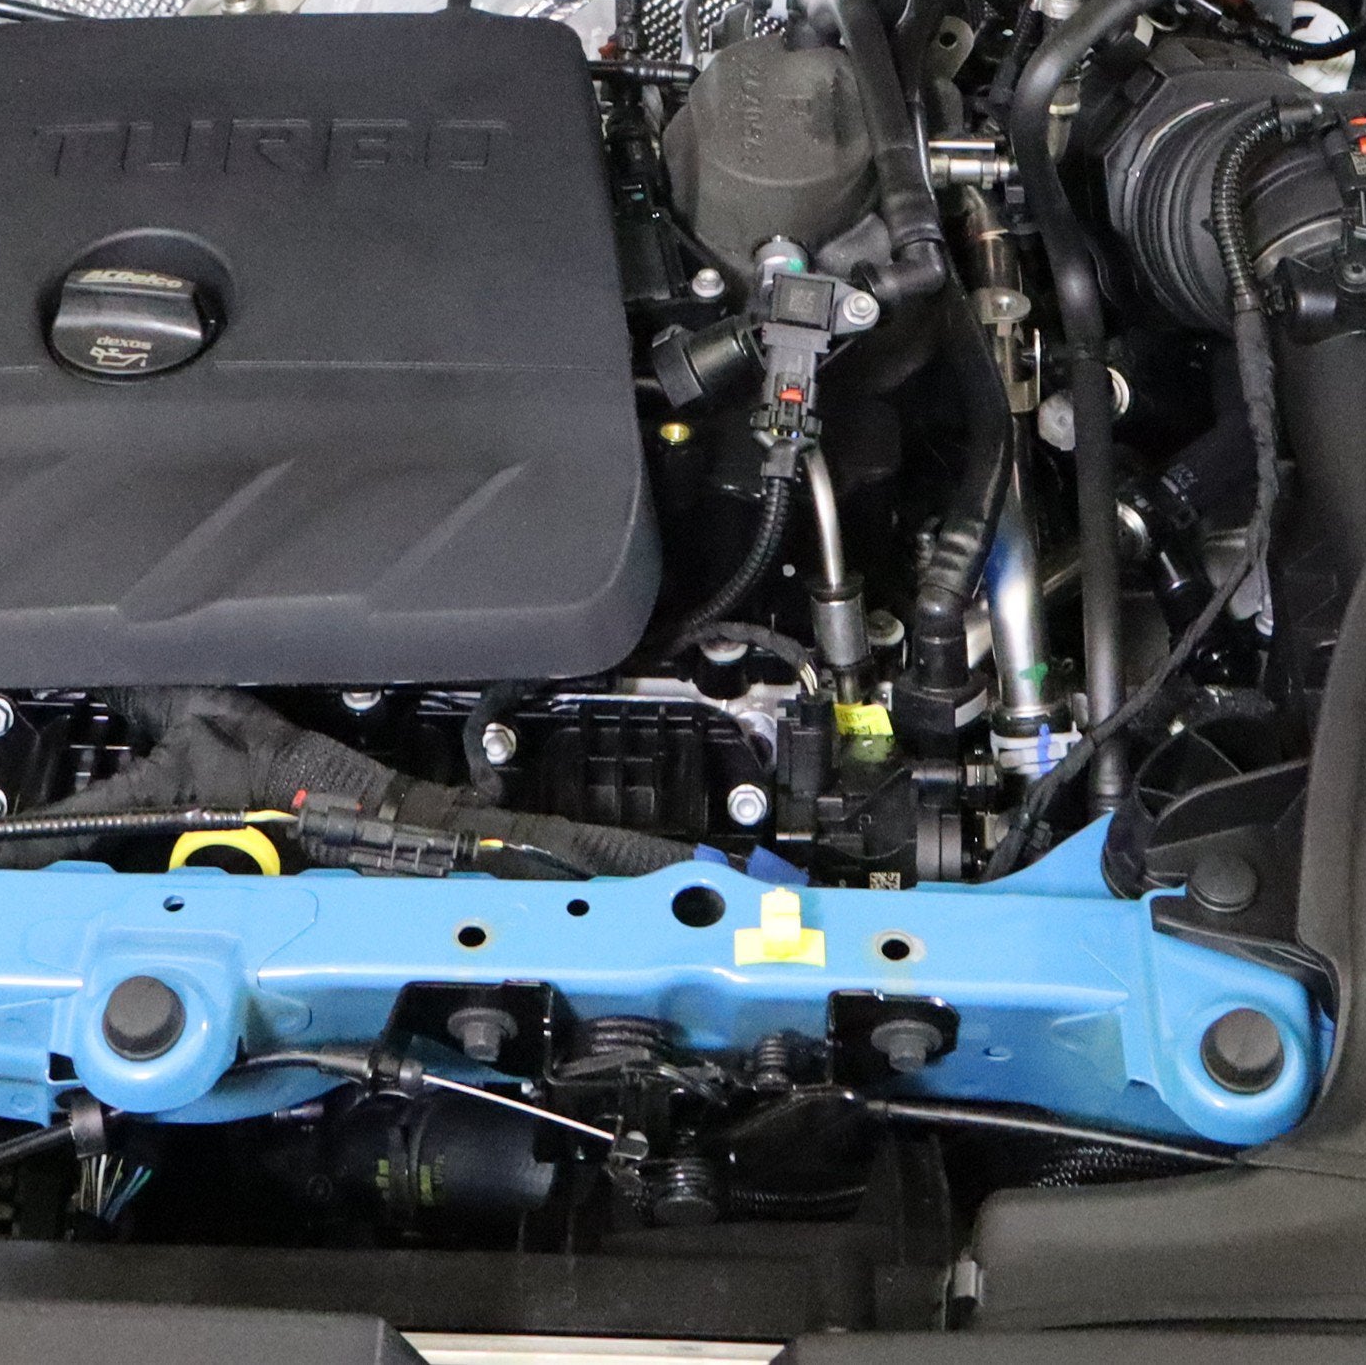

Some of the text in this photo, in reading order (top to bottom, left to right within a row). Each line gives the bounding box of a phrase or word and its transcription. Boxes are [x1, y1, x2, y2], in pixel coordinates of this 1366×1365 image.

[34, 118, 511, 176] TURBO
[80, 270, 183, 288] ACDelco
[96, 335, 152, 350] dexos
